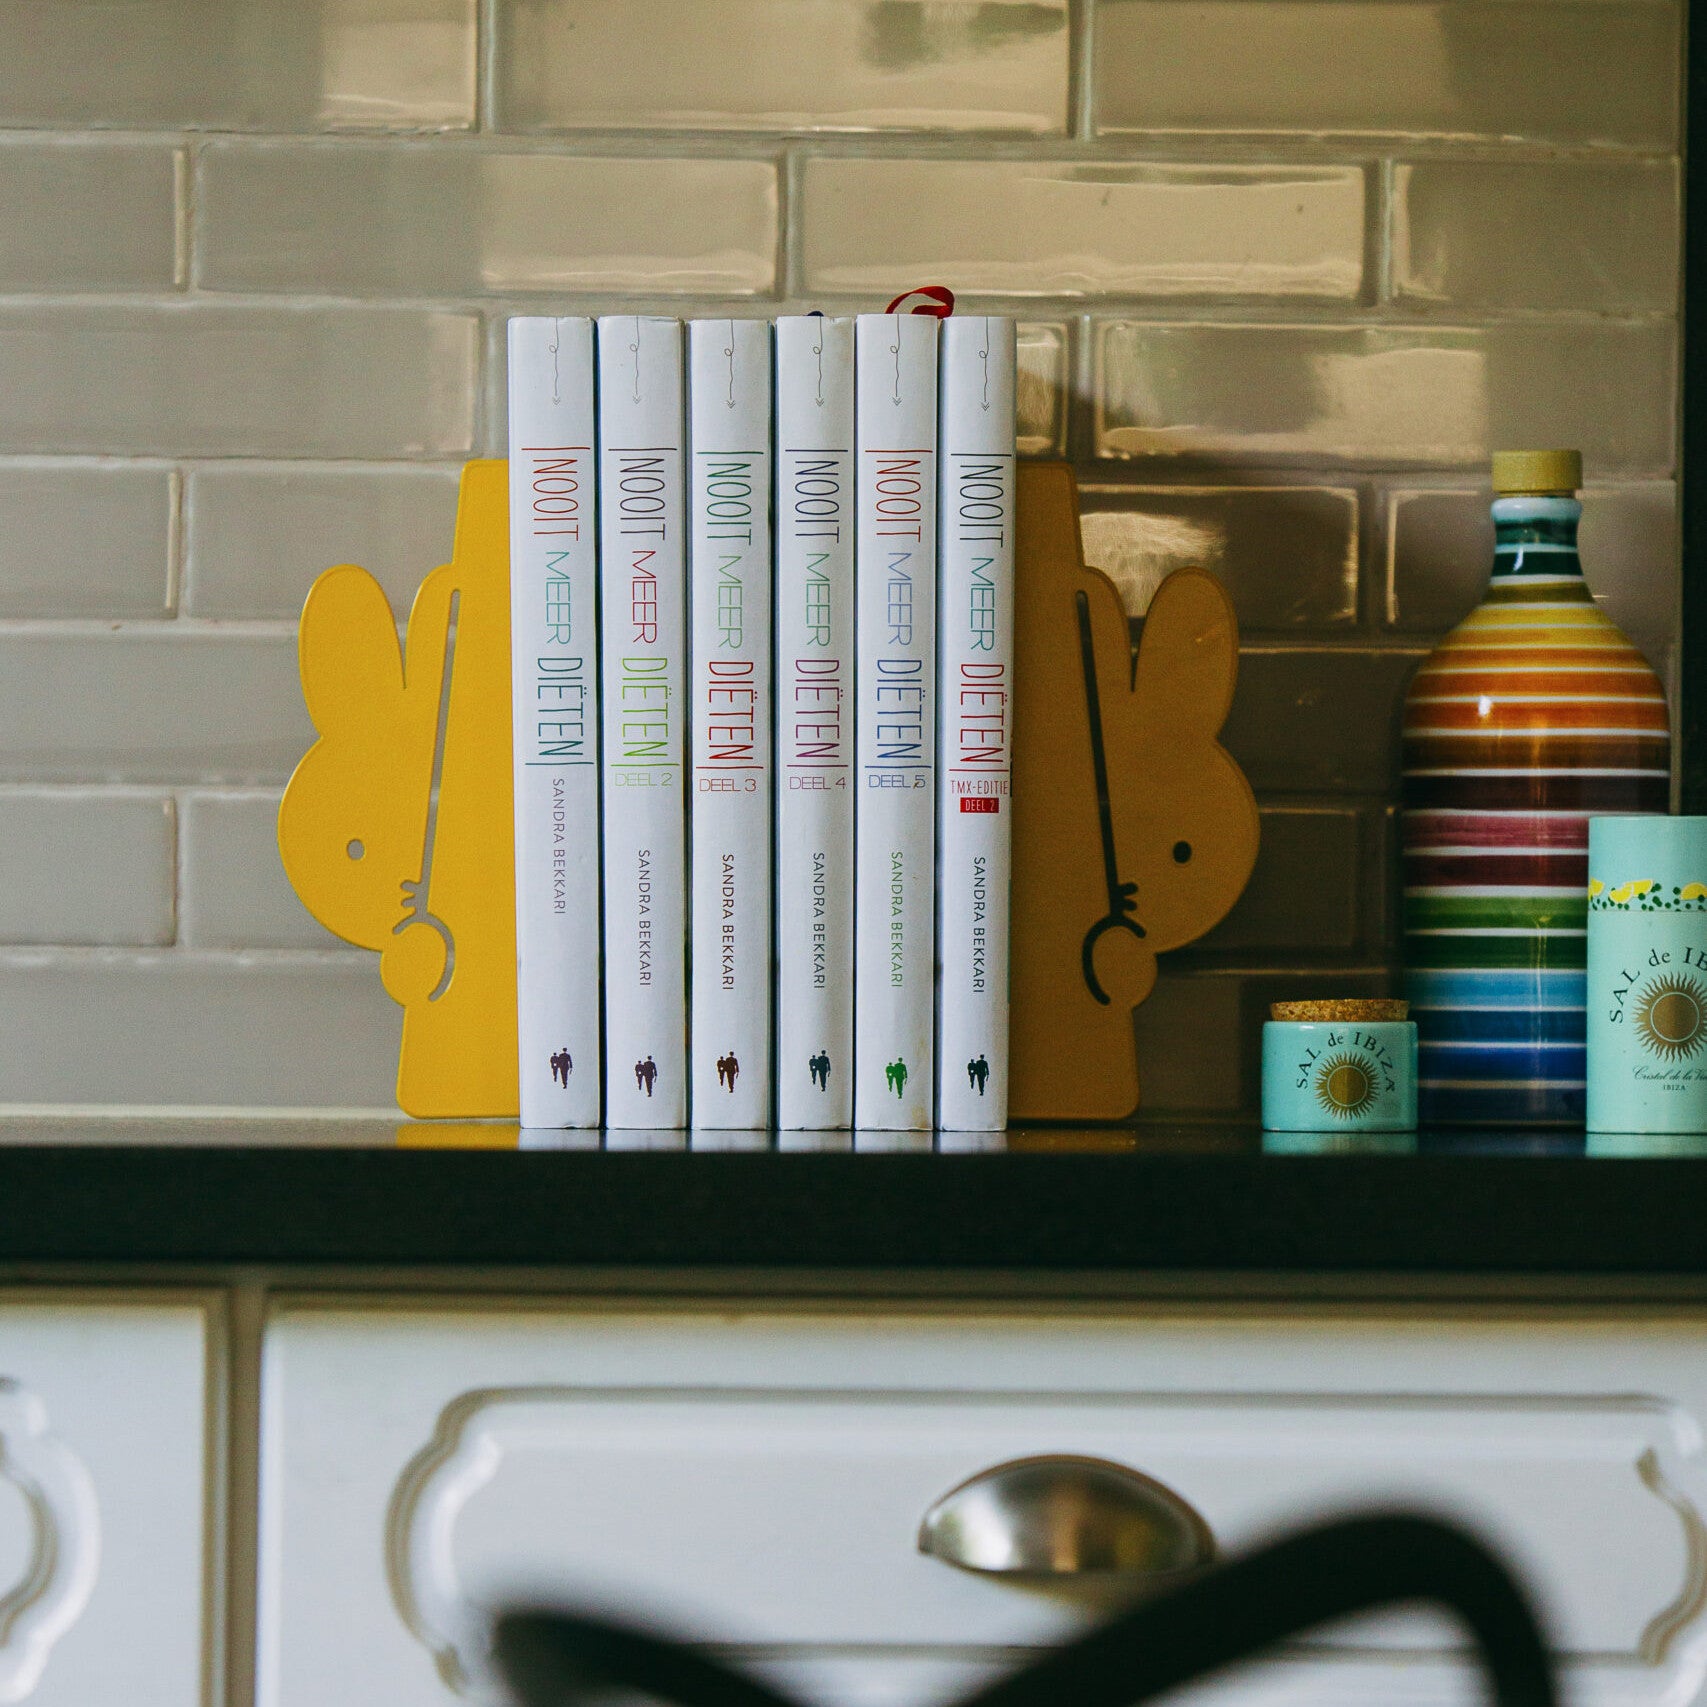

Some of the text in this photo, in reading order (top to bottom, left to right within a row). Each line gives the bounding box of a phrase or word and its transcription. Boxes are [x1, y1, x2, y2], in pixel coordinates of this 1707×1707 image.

[533, 459, 588, 756] NOOIT MEER DIËTEN
[619, 458, 672, 757] NOOIT MEER DIËTEN
[706, 463, 759, 760] NOOIT MEER DIËTEN
[795, 460, 844, 758] NOOIT MEER DIËTEN
[876, 460, 926, 759] NOOIT MEER DIËTEN
[959, 465, 1008, 763] NOOIT MEER DIËTEN
[553, 779, 567, 913] SANDRA BEKKARI
[616, 773, 672, 786] DEEL 2
[699, 778, 756, 792] DEEL 3
[789, 776, 846, 790] DEEL 4
[868, 774, 926, 789] DEEL 5
[951, 779, 1009, 795] TMX-EDITIE
[965, 800, 996, 811] DEEL 2
[638, 850, 651, 986] SANDRA BEKKARI
[722, 853, 735, 989] SANDRA BEKKARI
[813, 853, 825, 989] SANDRA BEKKARI
[891, 852, 905, 987] SANDRA BEKKARI
[973, 857, 987, 992] SANDRA BEKKARI
[1610, 968, 1641, 1024] SAL
[1648, 948, 1671, 967] de
[1296, 1031, 1396, 1093] SAL de IBIZA
